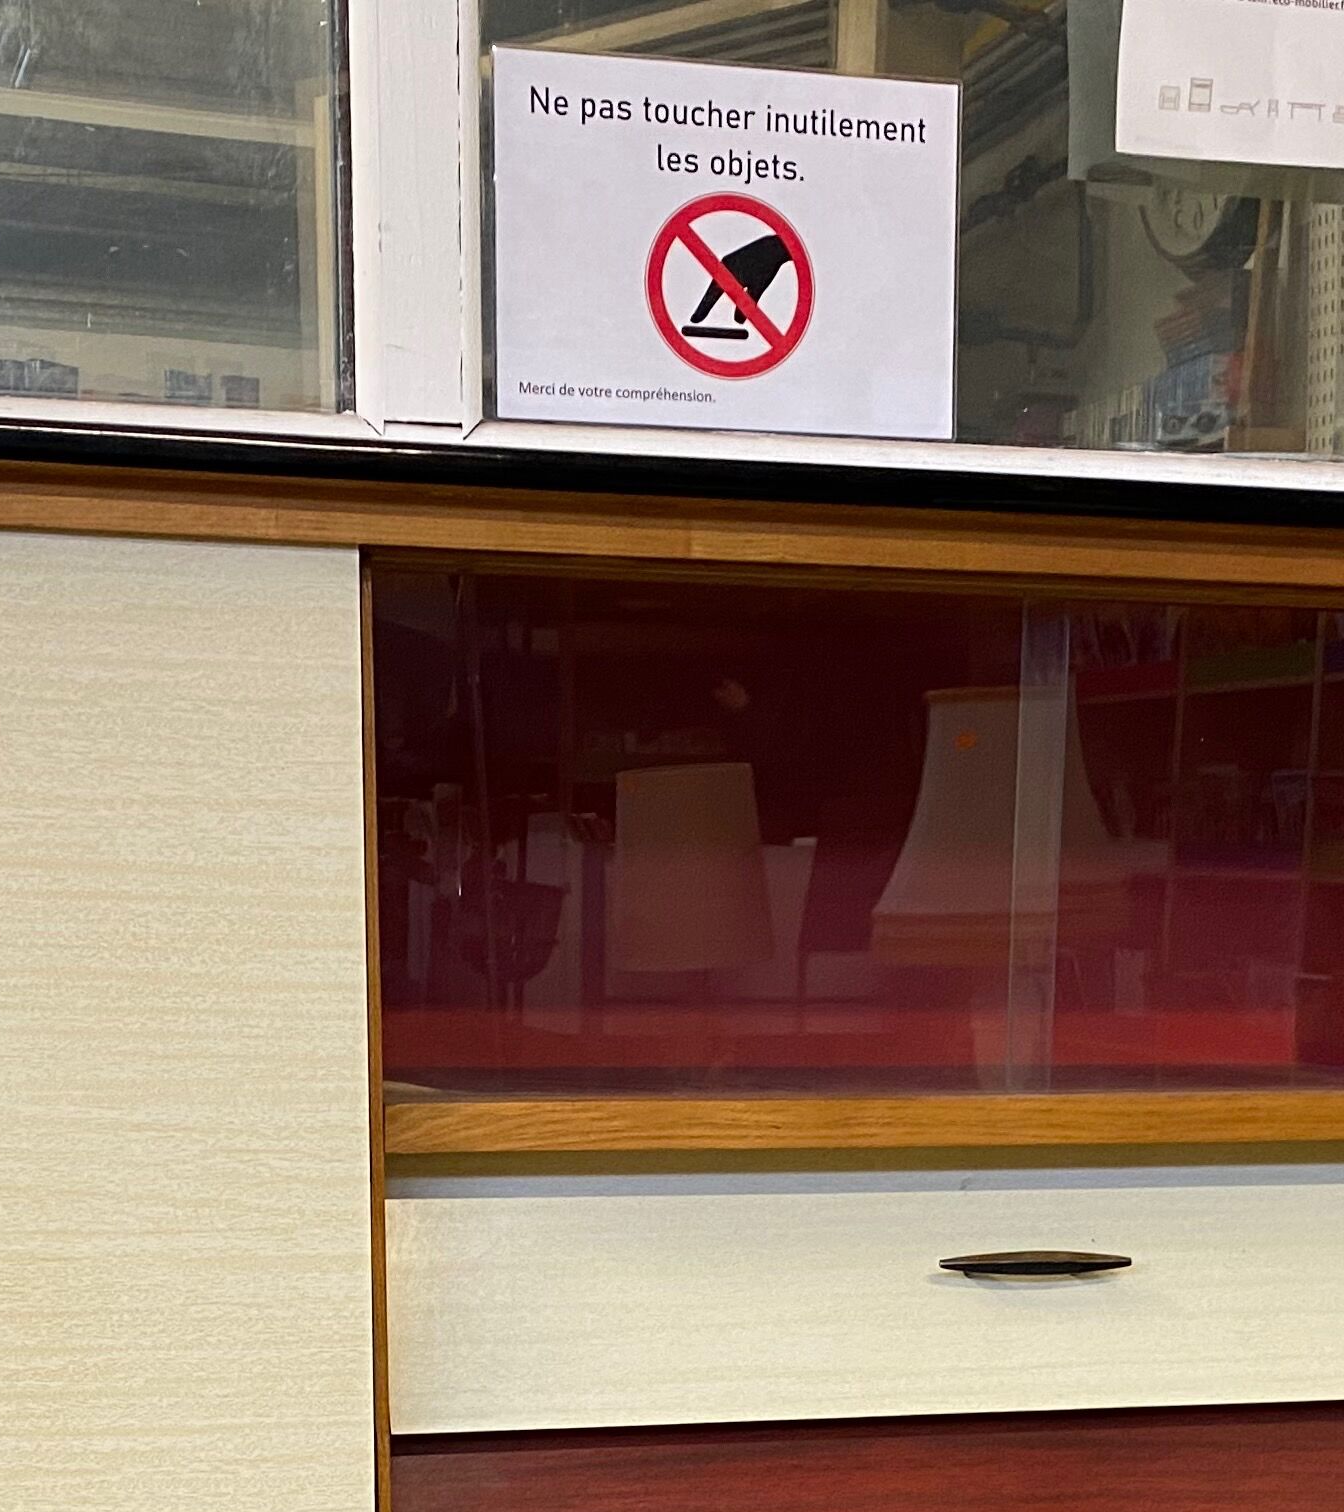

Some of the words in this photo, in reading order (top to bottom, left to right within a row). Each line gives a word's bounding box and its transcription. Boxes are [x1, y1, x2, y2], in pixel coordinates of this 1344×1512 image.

[530, 85, 568, 116] Ne
[581, 97, 632, 125] pas
[643, 96, 756, 130] toucher
[766, 104, 926, 144] inutilement
[657, 143, 699, 173] les
[710, 149, 804, 185] objets.
[519, 381, 556, 395] Merci
[558, 383, 575, 397] de
[578, 386, 612, 398] votre
[615, 387, 717, 403] compréhension.
